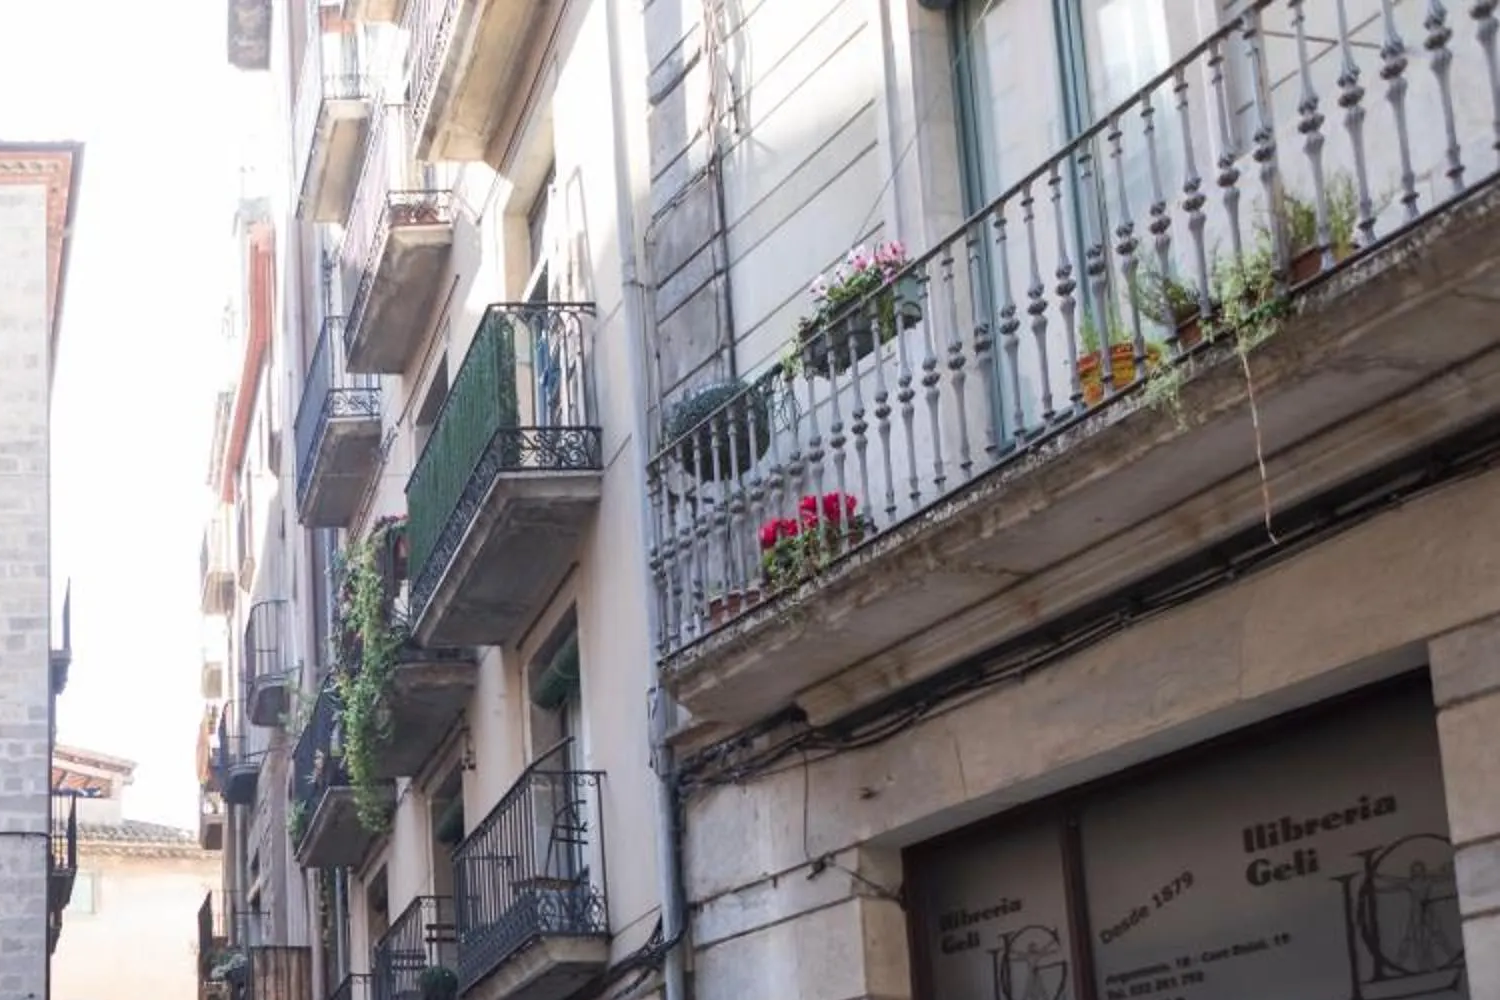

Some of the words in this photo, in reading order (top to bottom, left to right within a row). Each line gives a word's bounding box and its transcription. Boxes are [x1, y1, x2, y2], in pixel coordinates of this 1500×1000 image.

[1242, 794, 1398, 853] llibreria
[1245, 848, 1320, 888] Geli
[938, 897, 1023, 932] llibreria
[1098, 904, 1152, 945] Desde
[1151, 869, 1195, 909] 1879
[941, 931, 981, 955] Geli
